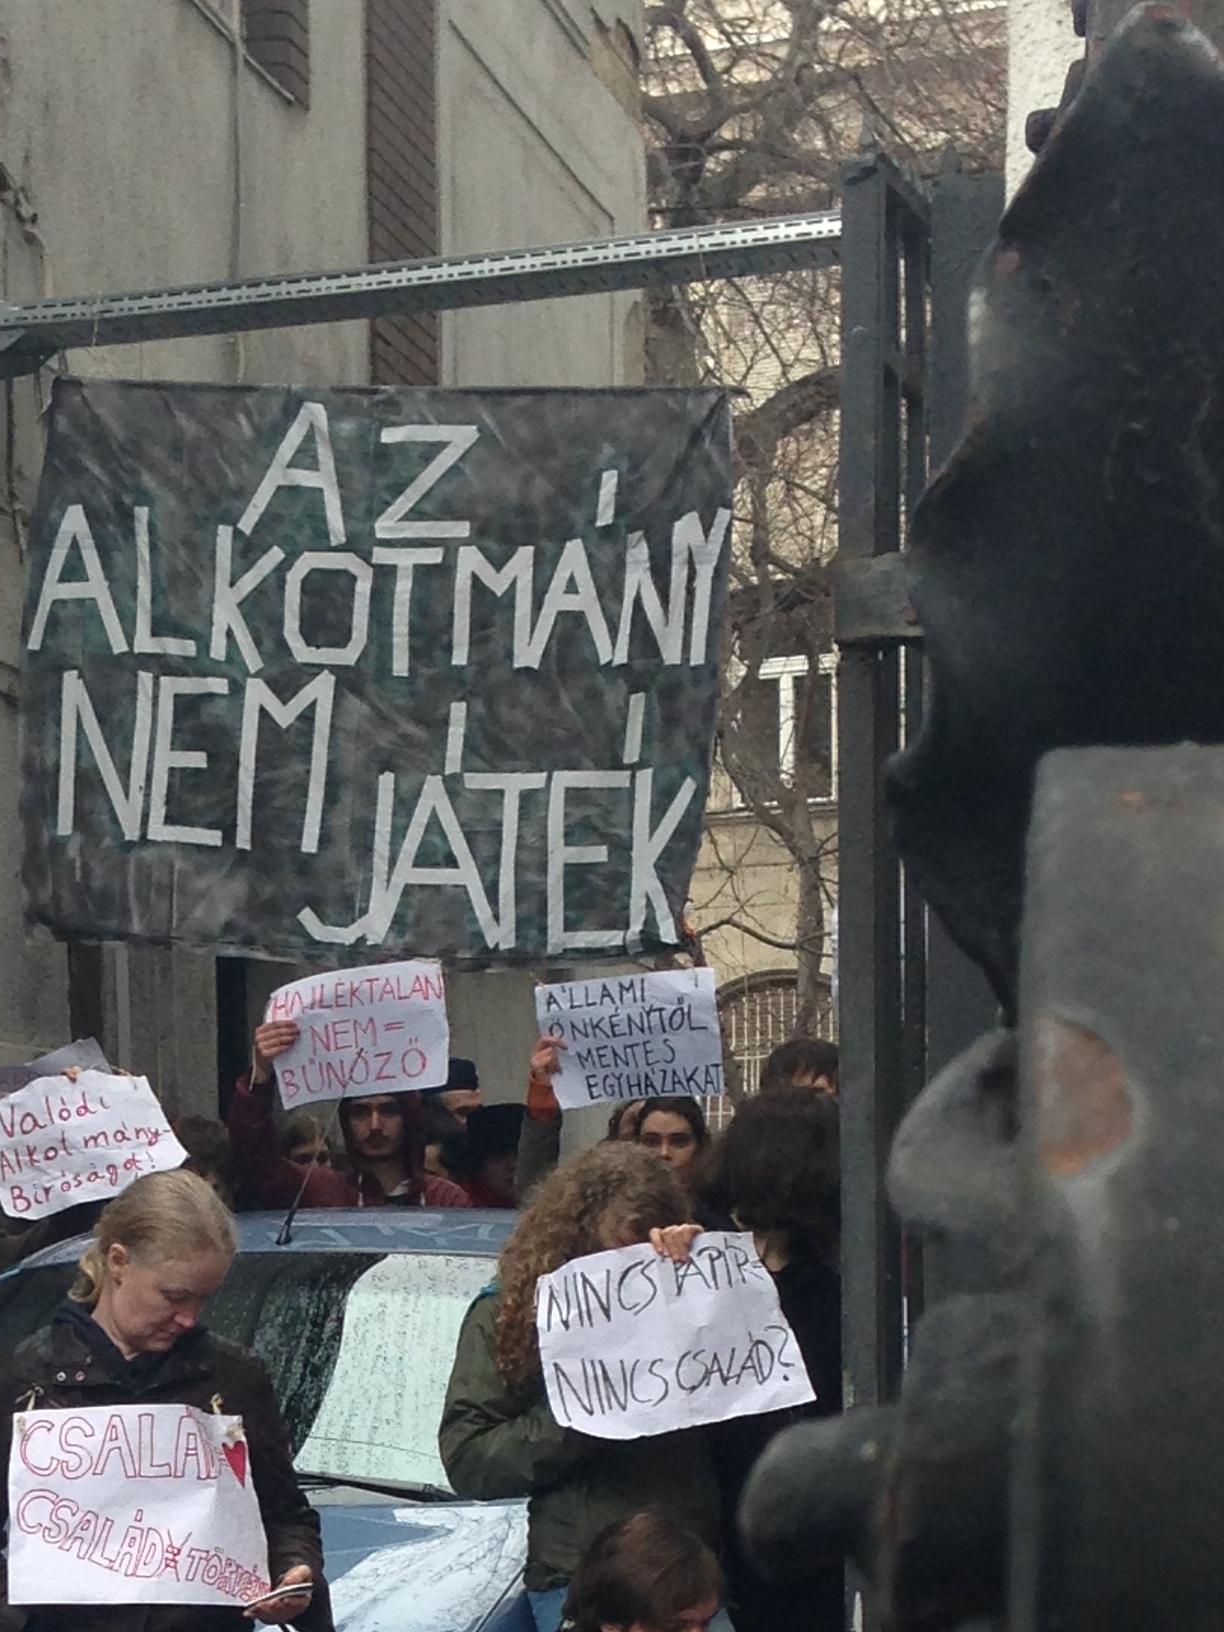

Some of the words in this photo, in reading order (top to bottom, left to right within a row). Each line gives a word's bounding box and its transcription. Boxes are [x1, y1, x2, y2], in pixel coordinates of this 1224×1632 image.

[237, 401, 479, 546] AZ
[26, 469, 731, 677] ALKOTMÁNY
[56, 669, 336, 854] NEM
[296, 692, 698, 955] JÁTÉK
[545, 977, 646, 1013] ÁLLAMI
[576, 1038, 676, 1070] MENTES
[545, 1257, 658, 1333] NINCS
[552, 1357, 670, 1422] NINCS
